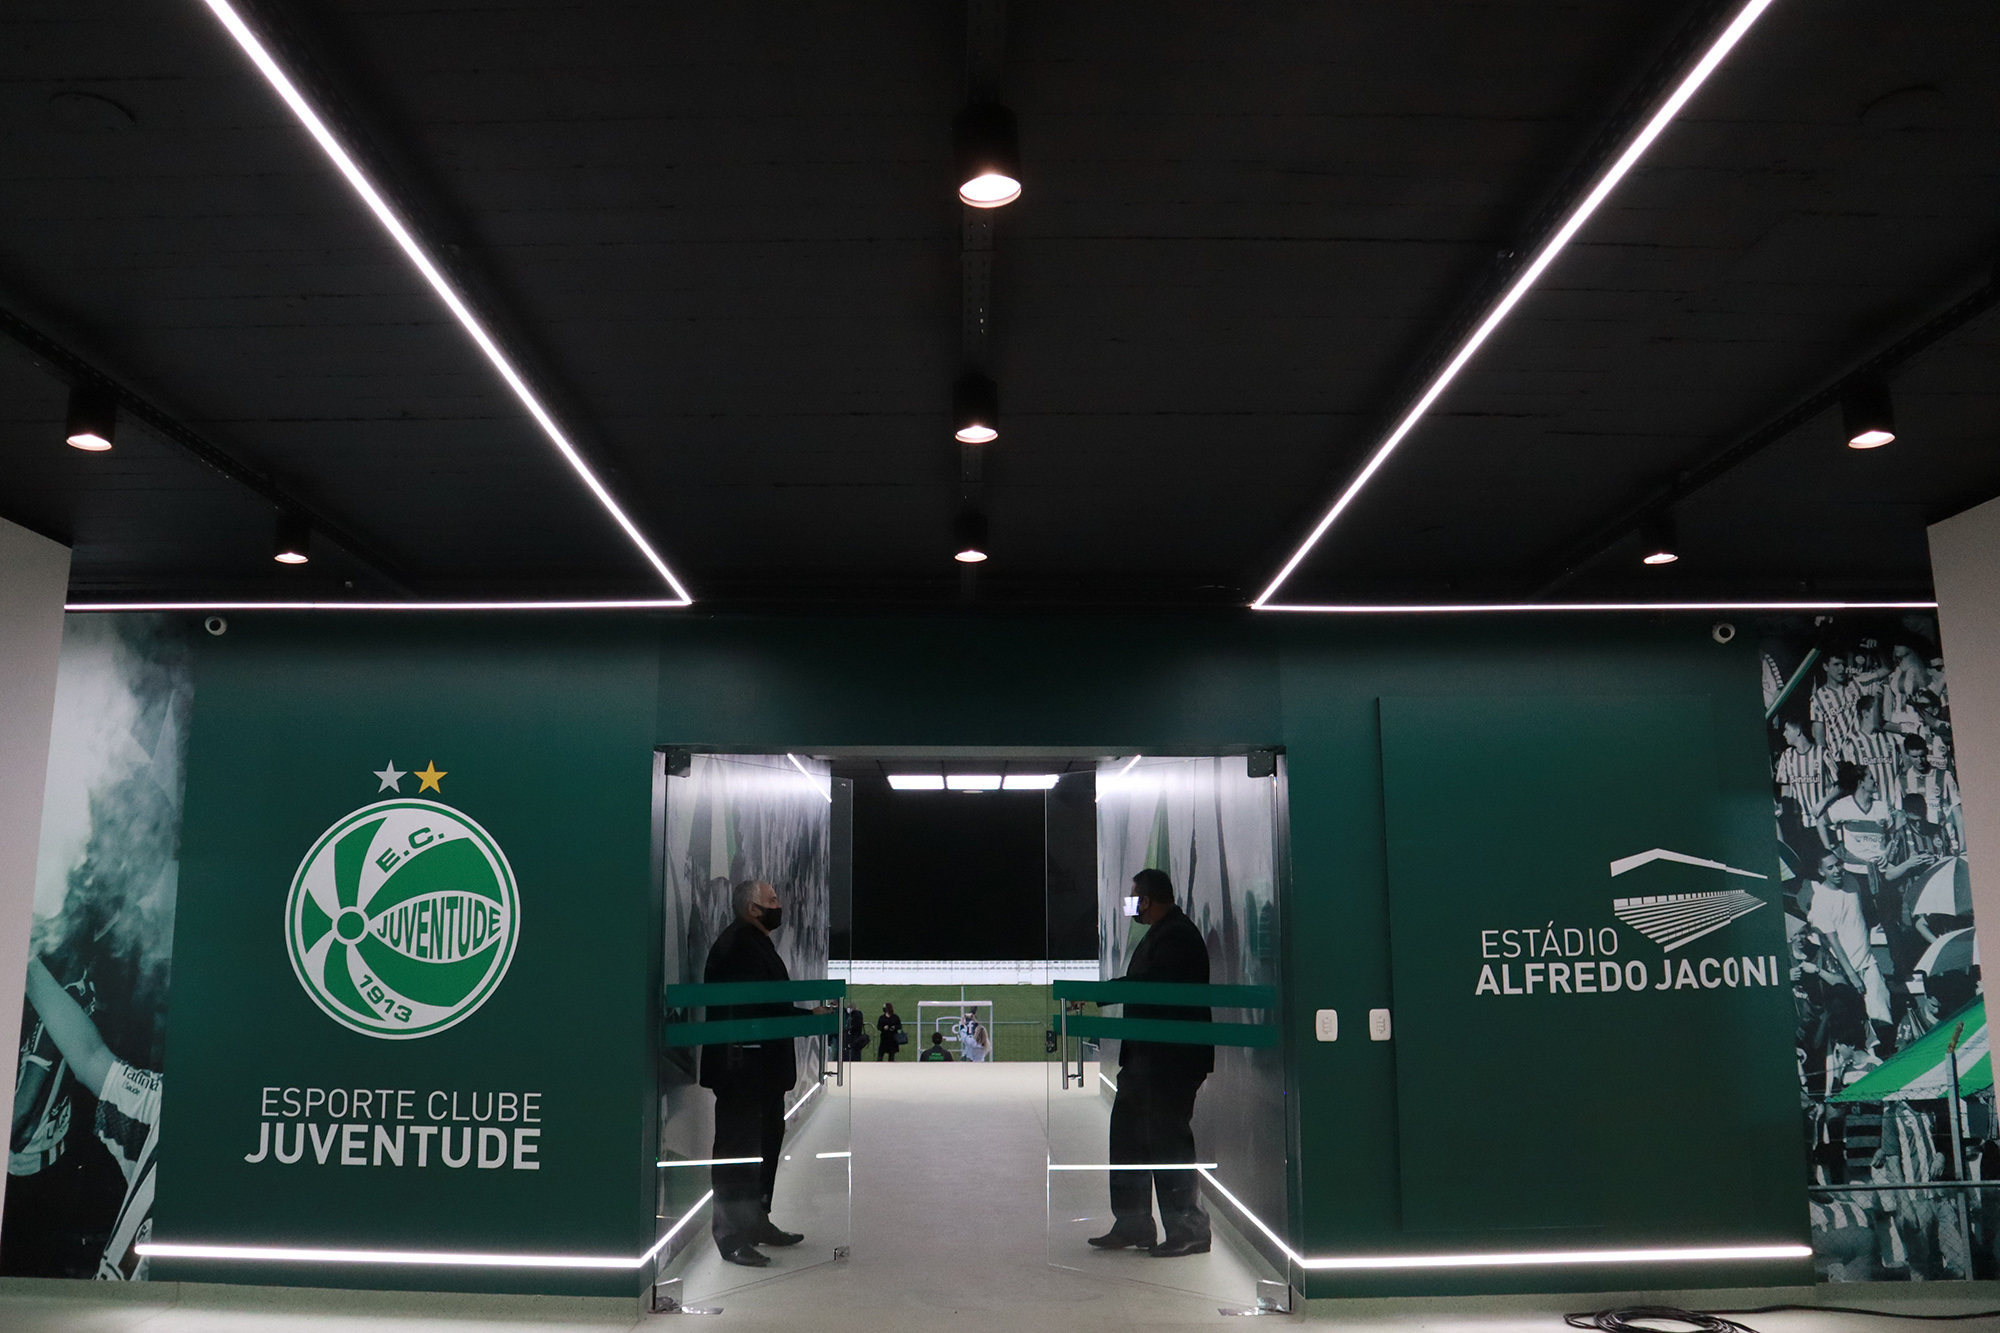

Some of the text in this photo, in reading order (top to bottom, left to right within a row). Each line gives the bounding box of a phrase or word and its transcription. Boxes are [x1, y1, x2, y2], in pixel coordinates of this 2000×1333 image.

[375, 827, 445, 873] E.C.
[377, 896, 502, 960] JUVENTUDE
[1481, 920, 1619, 958] ESTÁDIO
[1475, 955, 1779, 995] ALFREDO JACONI
[359, 974, 413, 1023] 1913
[261, 1087, 542, 1122] ESPORTE CLUBE
[244, 1122, 542, 1170] JUVENTUDE
